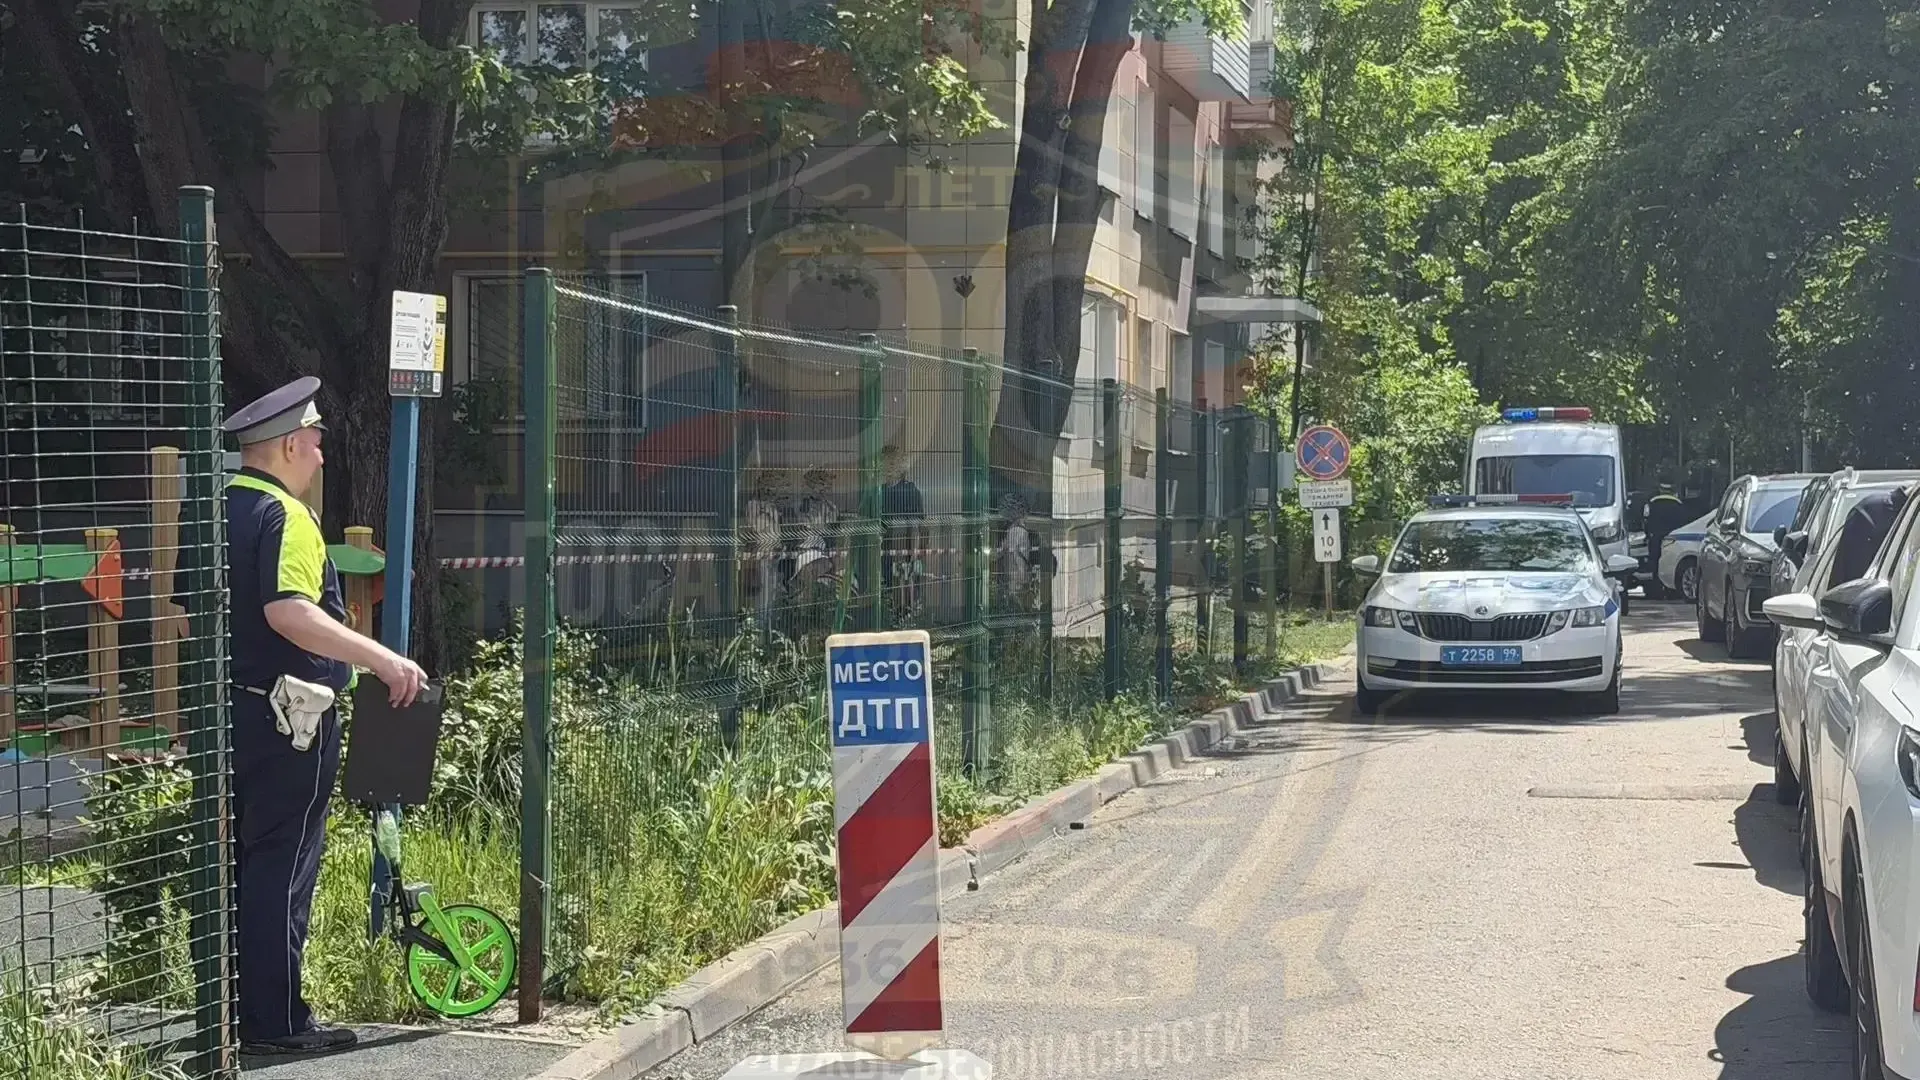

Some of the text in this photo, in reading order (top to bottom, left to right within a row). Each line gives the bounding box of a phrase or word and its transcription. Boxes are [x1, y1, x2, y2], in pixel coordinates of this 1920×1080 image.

[1320, 536, 1335, 547] 10
[1461, 648, 1495, 662] 2258
[1503, 648, 1517, 658] 99
[834, 659, 923, 684] МЕСТО
[838, 697, 920, 738] ДТП
